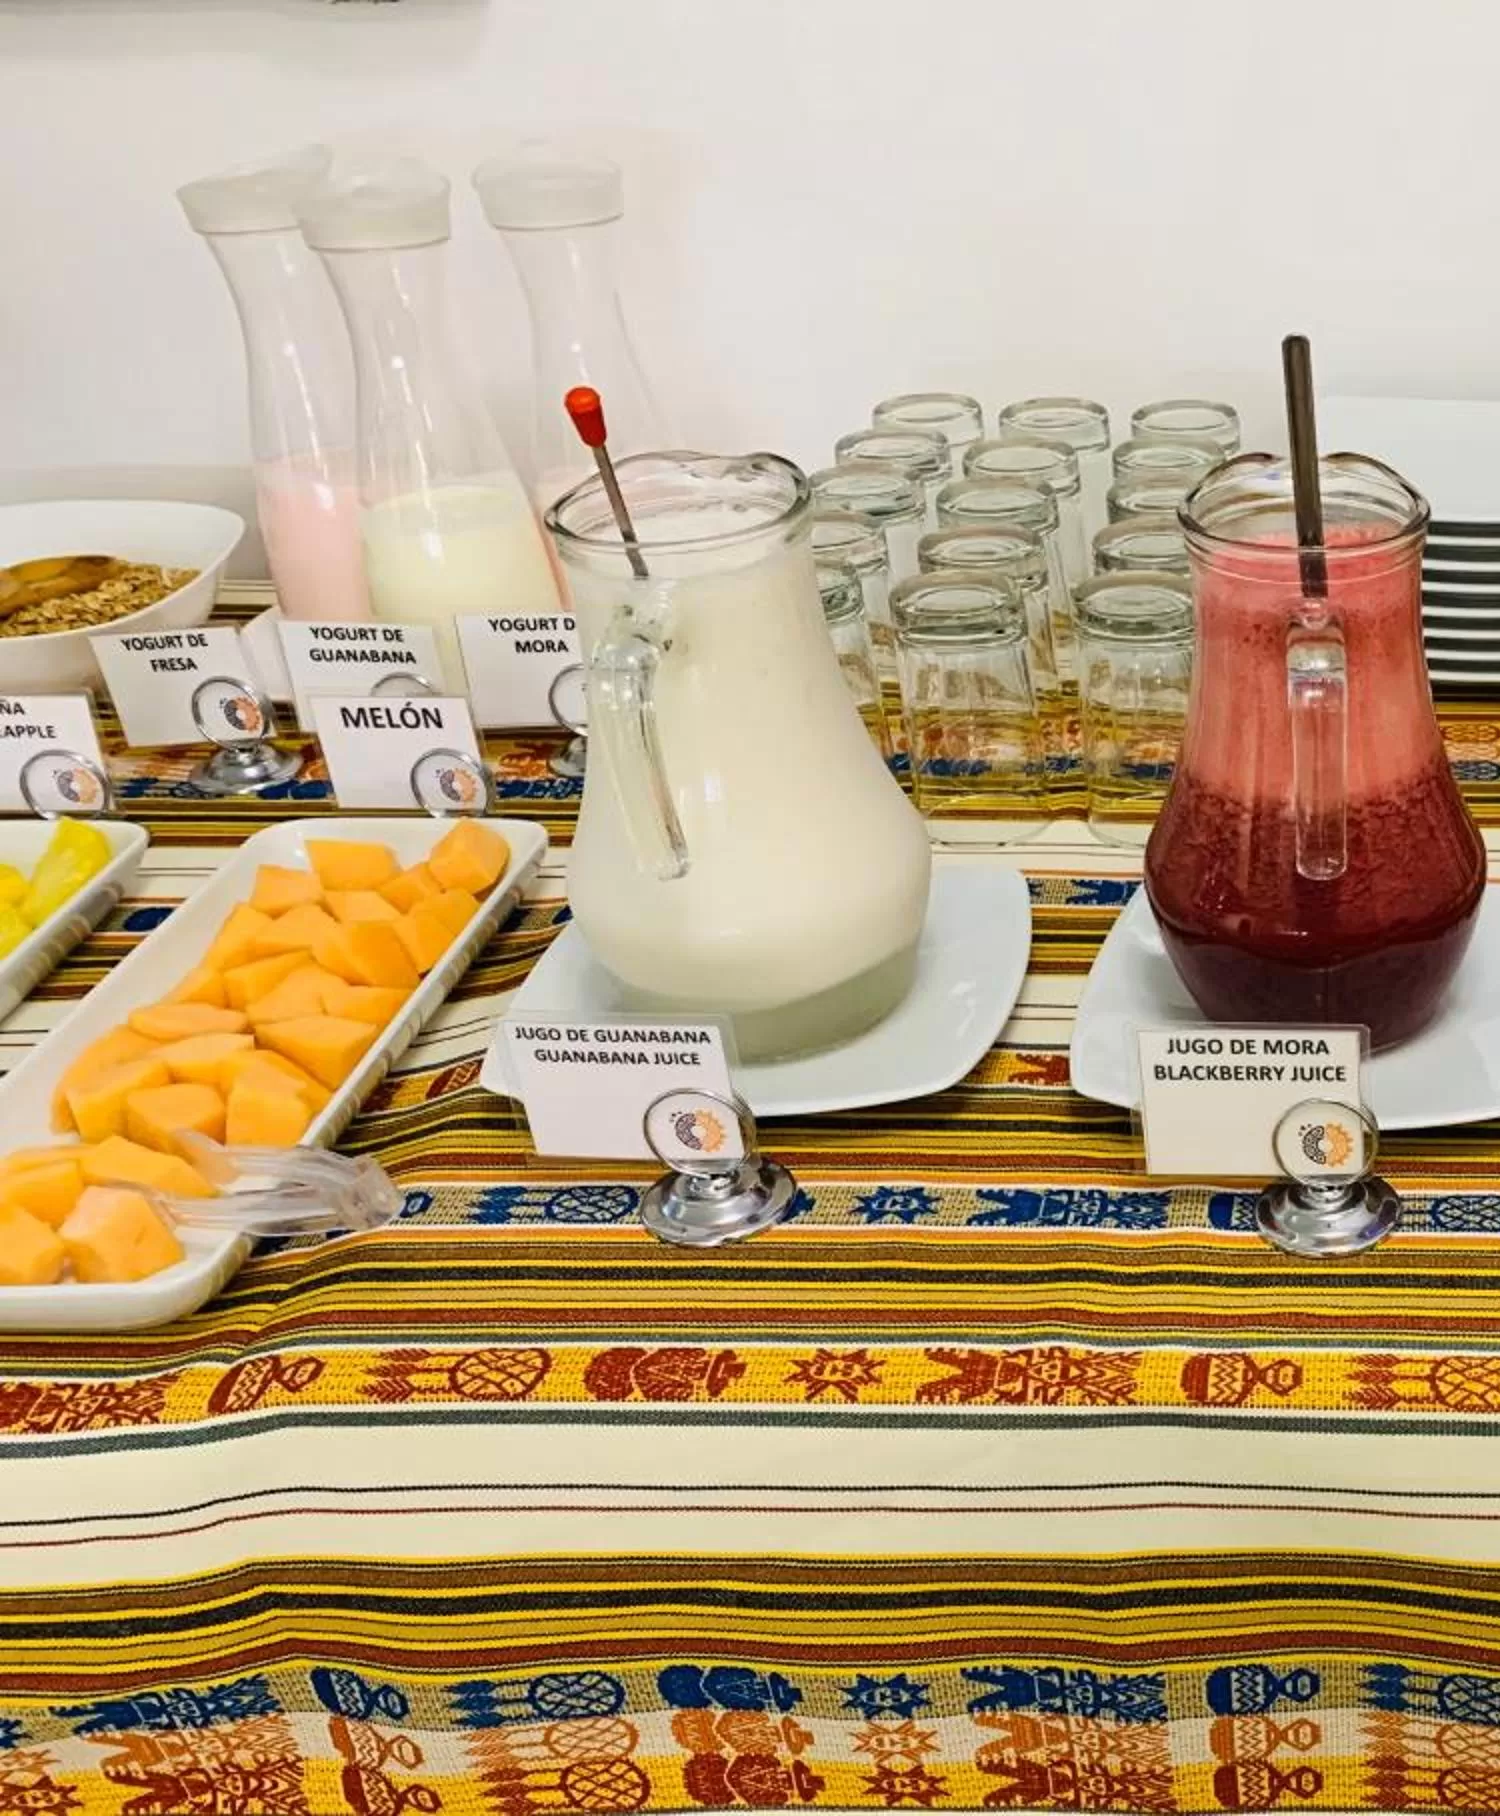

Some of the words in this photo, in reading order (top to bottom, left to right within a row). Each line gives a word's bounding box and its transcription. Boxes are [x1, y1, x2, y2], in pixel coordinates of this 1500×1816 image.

[486, 617, 558, 632] YOGURT
[563, 617, 575, 631] D
[120, 635, 182, 651] YOGURT
[187, 633, 208, 648] DE
[309, 626, 377, 641] YOGURT
[382, 629, 404, 643] DE
[515, 639, 569, 653] MORA
[309, 647, 417, 664] GUANABANA
[150, 657, 198, 672] FRESA
[340, 701, 443, 729] MELÓN
[0, 725, 57, 739] APPLE
[516, 1026, 561, 1041] JUGO
[567, 1028, 590, 1042] DE
[594, 1029, 711, 1044] GUANABANA
[1167, 1038, 1223, 1055] JUGO
[1230, 1038, 1257, 1055] DE
[1263, 1039, 1329, 1055] MORA
[534, 1049, 649, 1066] GUANABANA
[653, 1052, 701, 1066] JUICE
[1154, 1065, 1285, 1082] BLACKBERRY
[1291, 1066, 1347, 1083] JUICE
